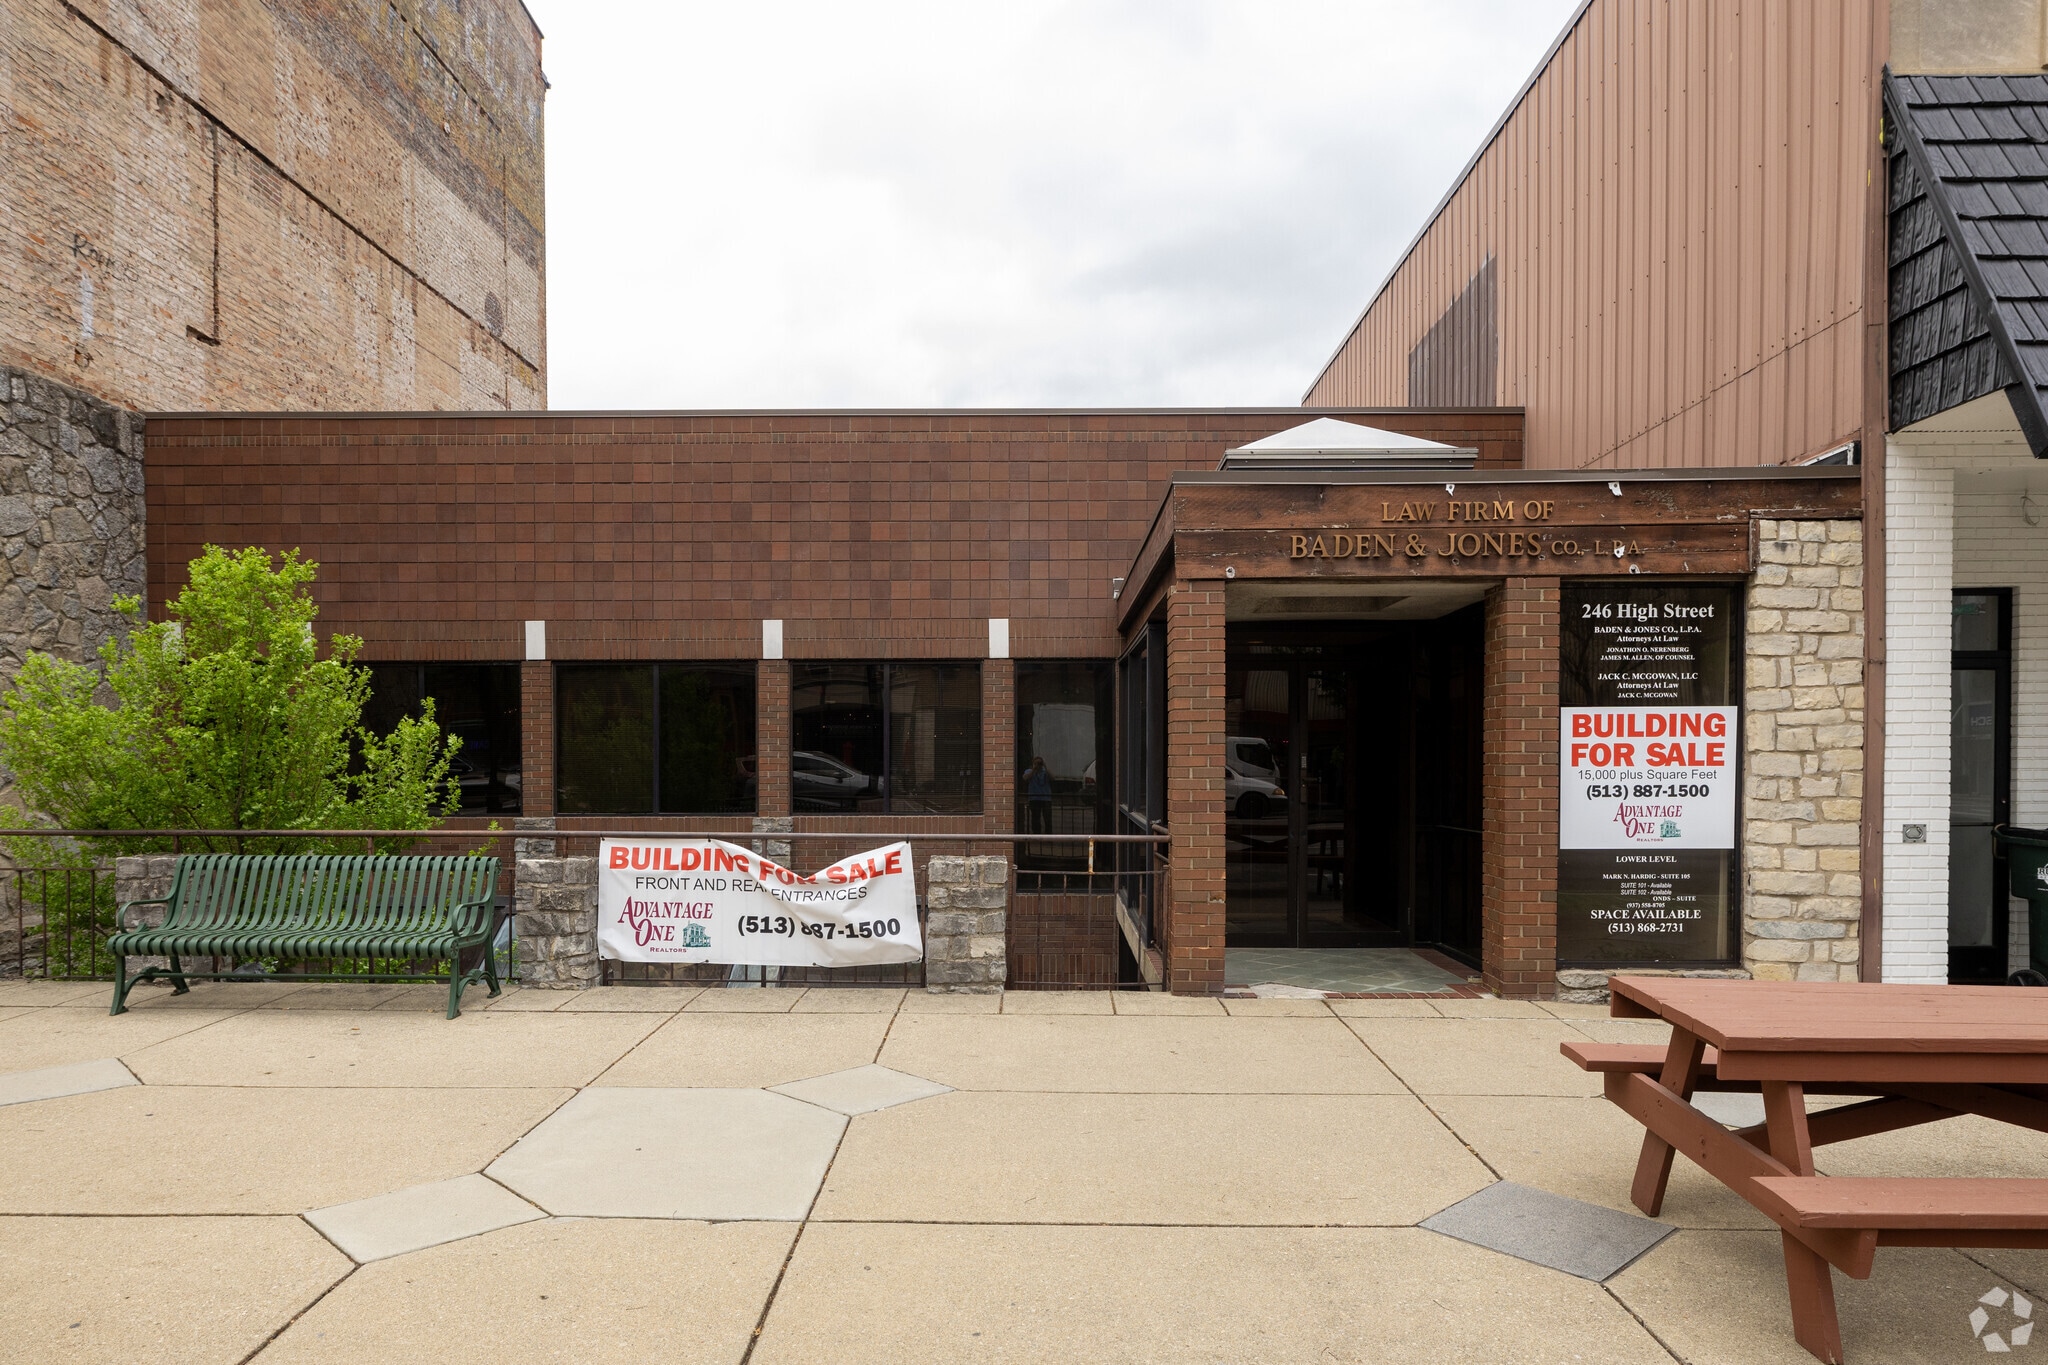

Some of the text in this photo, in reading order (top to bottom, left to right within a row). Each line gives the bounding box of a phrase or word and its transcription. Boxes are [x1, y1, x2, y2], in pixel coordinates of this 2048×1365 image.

[1381, 500, 1554, 521] LAW FIRM OF
[1290, 534, 1396, 558] BADEN
[1405, 533, 1426, 557] &
[1438, 533, 1542, 557] JONES
[1582, 603, 1714, 622] 246 High Street
[1662, 626, 1678, 634] CO.,
[1617, 682, 1651, 690] Attorneys
[1572, 713, 1726, 737] BUILDING
[1571, 743, 1725, 767] FOR SALE
[1578, 769, 1717, 781] 15,000 plus Square Feet
[1587, 785, 1709, 800] (513) 887-1500
[1613, 802, 1682, 826] ADVANTAGE
[1626, 818, 1654, 838] ONE
[825, 851, 902, 884] SALE
[636, 877, 868, 902] FRONT AND REA ENTRANCES
[618, 896, 714, 930] ADVANTAGE
[1591, 910, 1701, 919] SPACE AVAILABLE
[635, 919, 674, 946] ONE
[738, 916, 796, 937] (513)
[1608, 923, 1683, 934] (513) 868-2731
